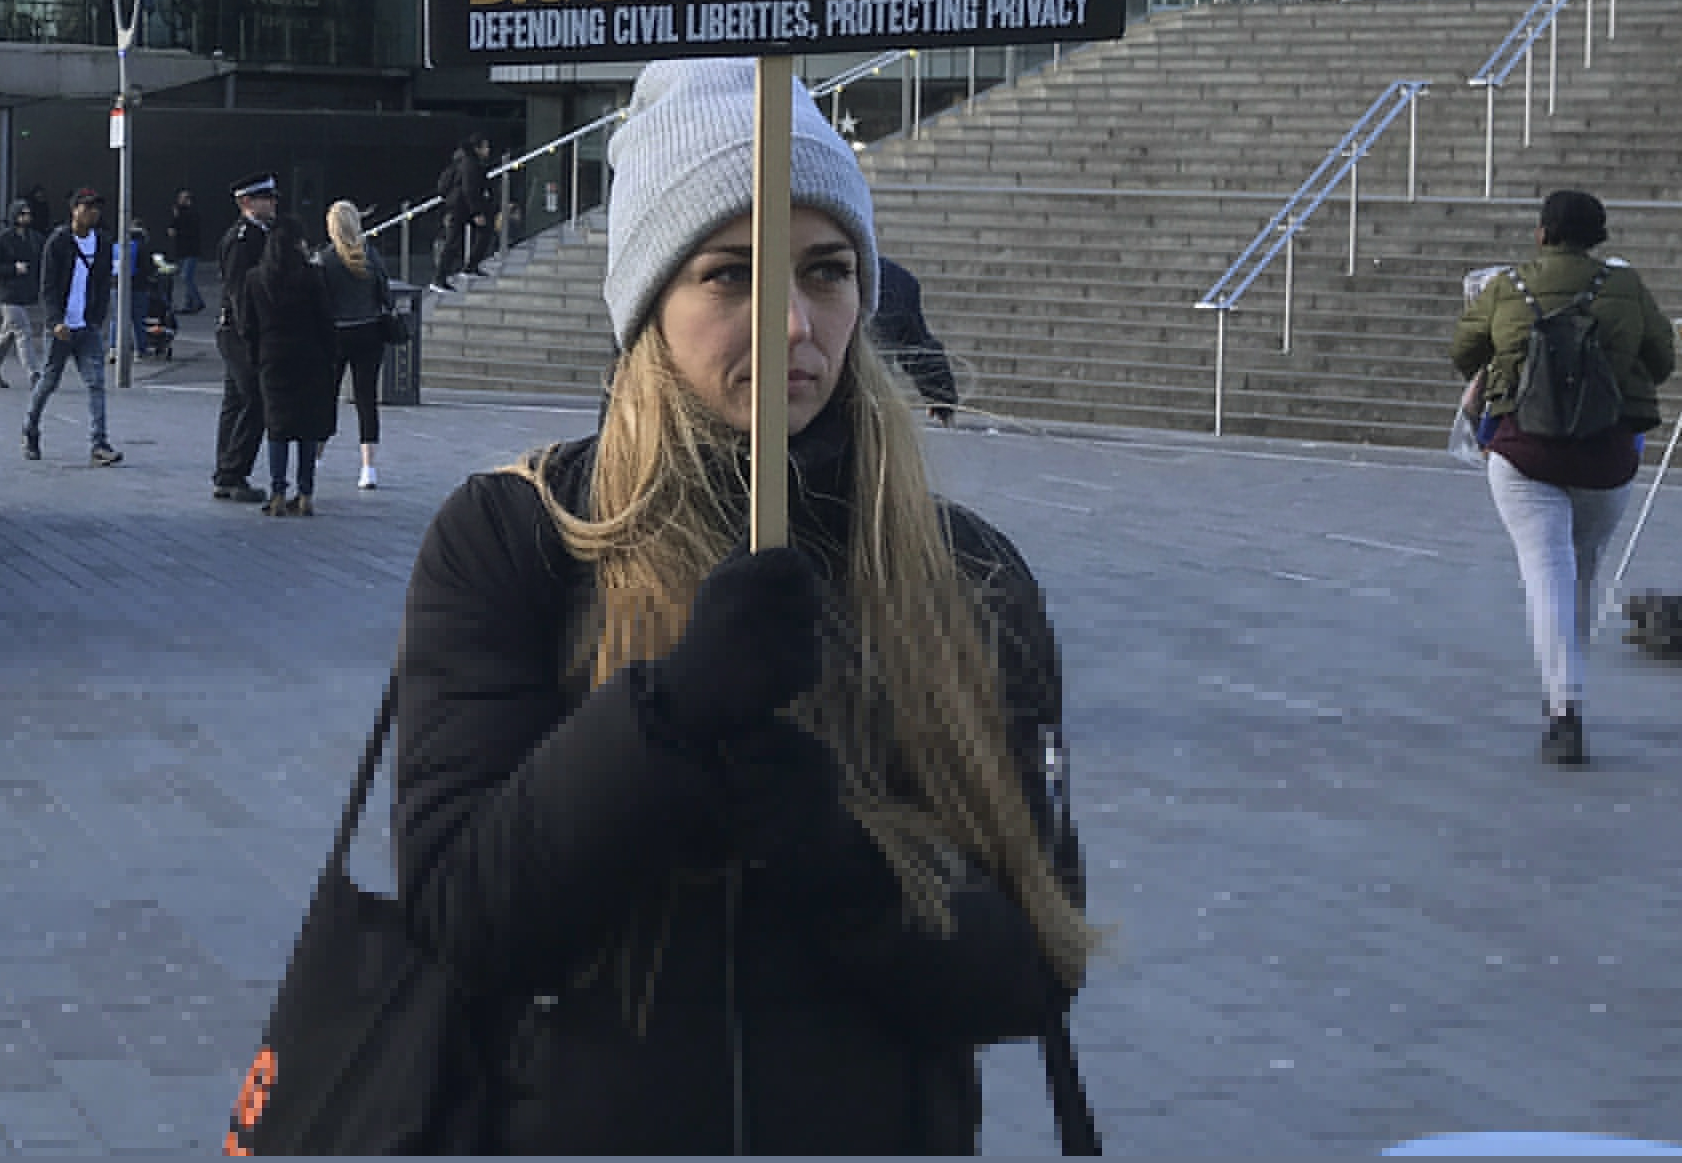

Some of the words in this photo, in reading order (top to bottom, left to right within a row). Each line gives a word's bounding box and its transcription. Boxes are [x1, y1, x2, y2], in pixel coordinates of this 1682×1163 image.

[468, 9, 606, 51] DEFENDING
[612, 4, 679, 45] CIVIL
[685, 0, 818, 40] LIBERTIES,
